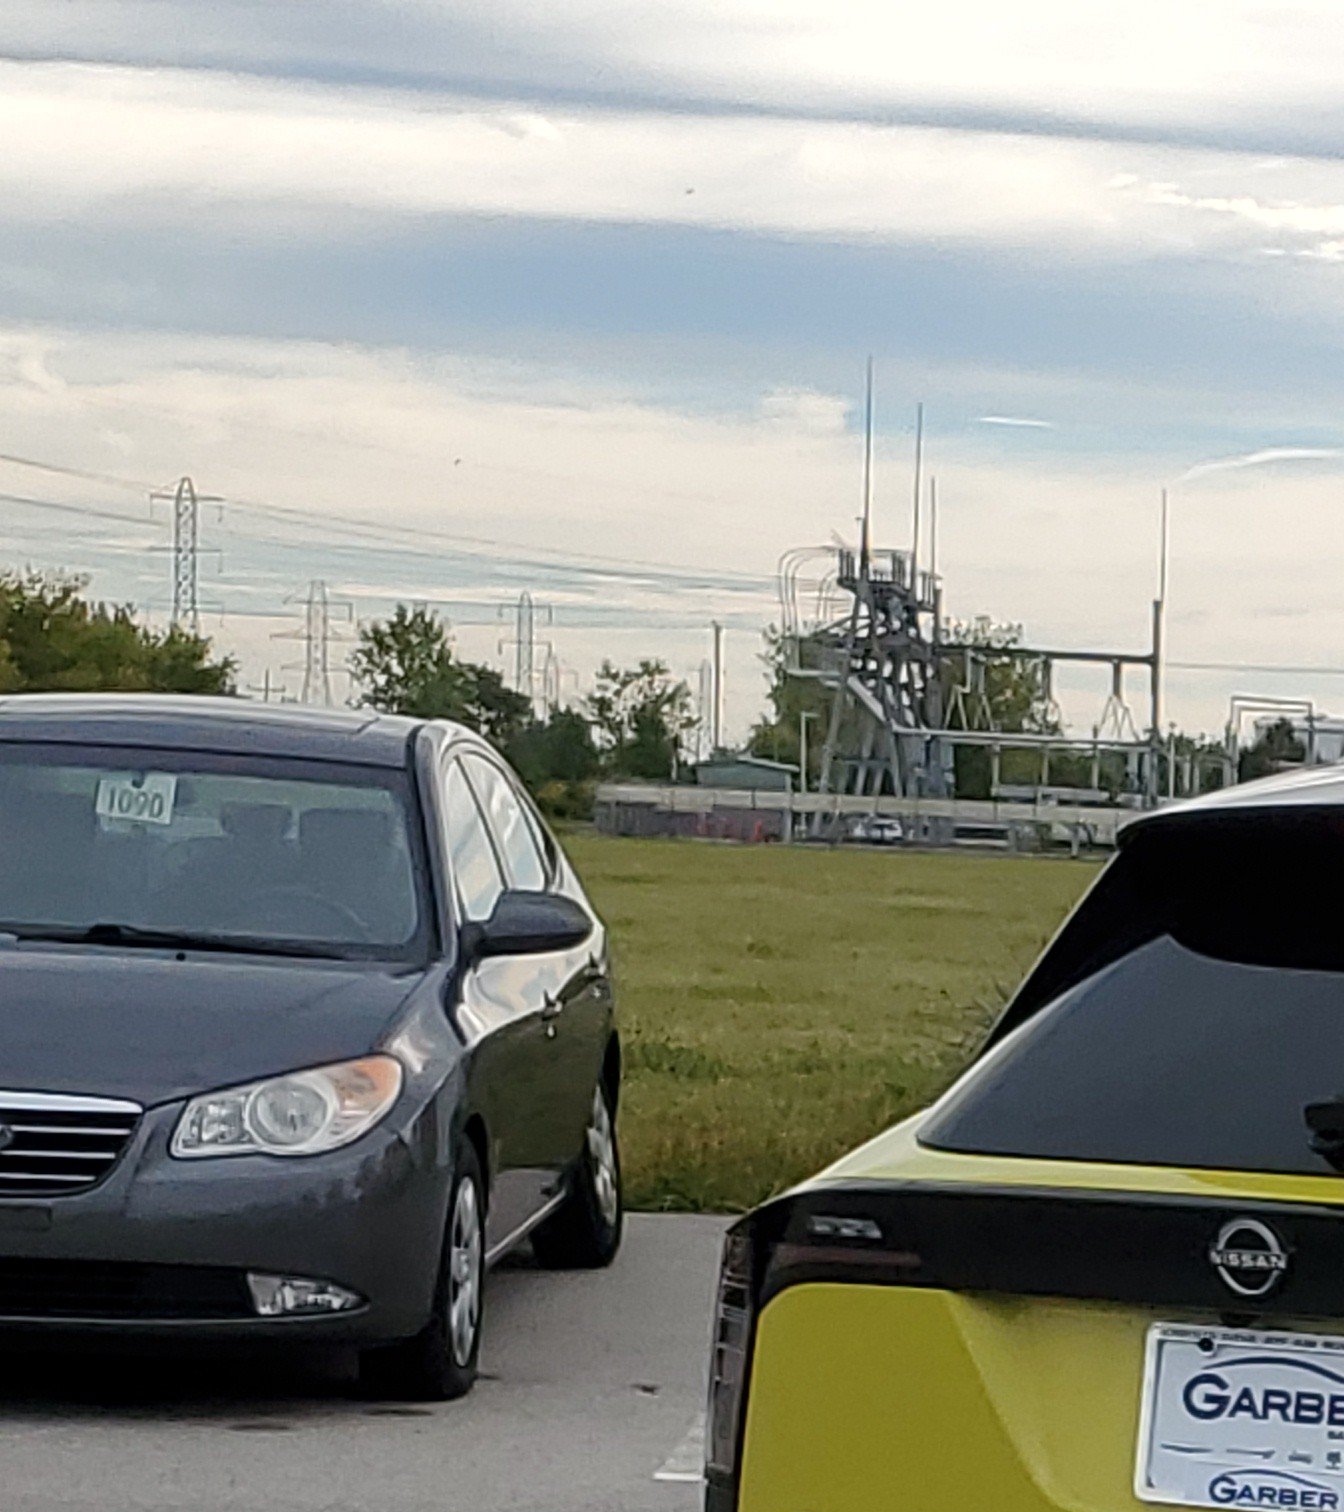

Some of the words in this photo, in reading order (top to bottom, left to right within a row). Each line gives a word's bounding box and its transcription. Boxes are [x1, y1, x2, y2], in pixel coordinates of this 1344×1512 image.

[108, 788, 164, 818] 1090
[1210, 1250, 1286, 1269] NISSAN
[1209, 1475, 1340, 1510] GARBER
